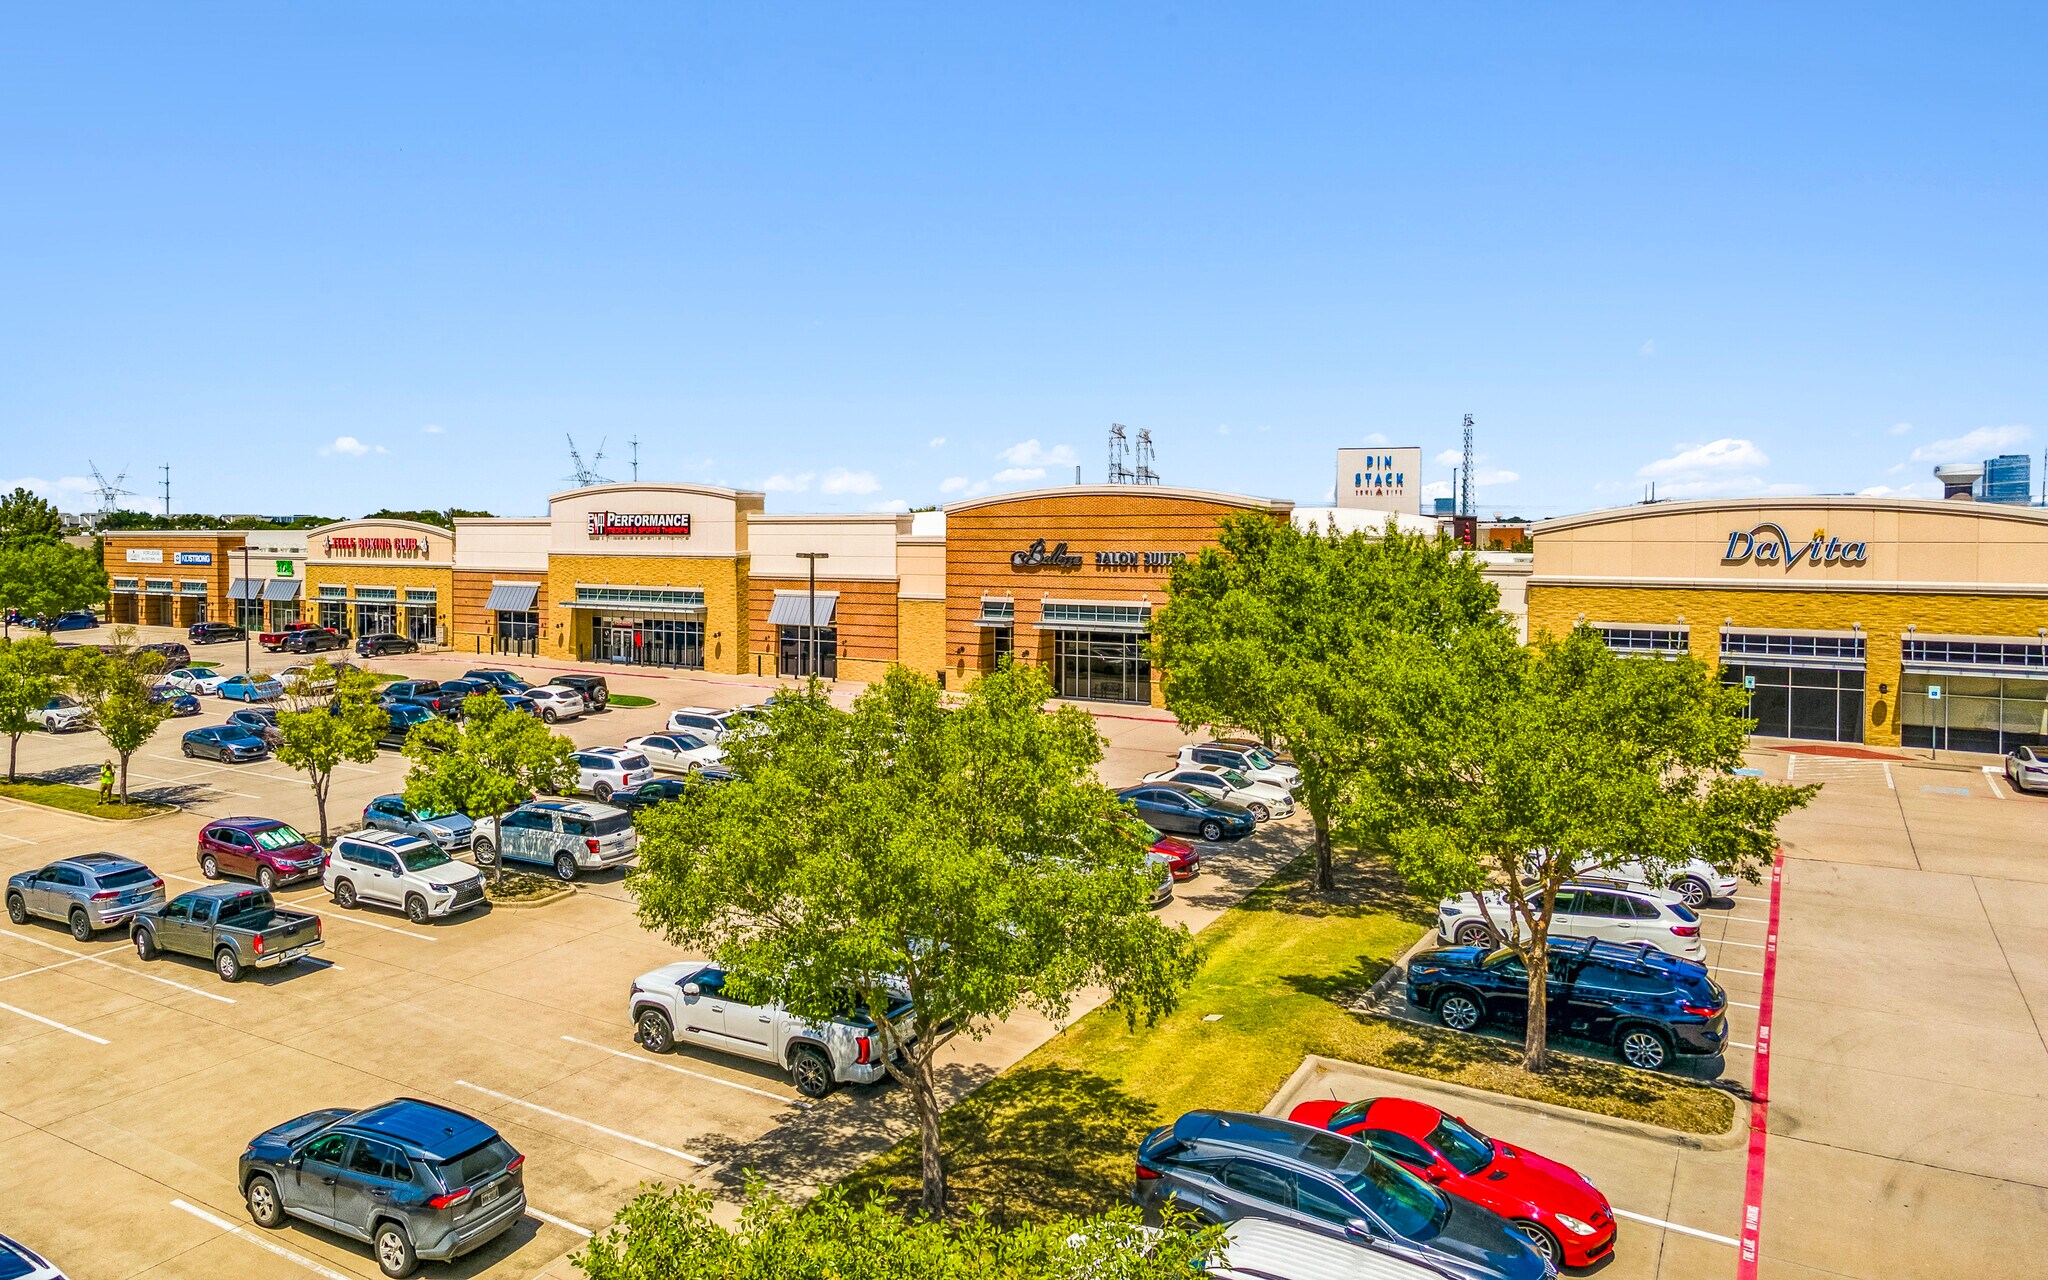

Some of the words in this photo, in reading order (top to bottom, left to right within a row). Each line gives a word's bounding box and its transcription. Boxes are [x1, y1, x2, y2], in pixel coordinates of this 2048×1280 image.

[1366, 455, 1392, 470] PIN
[1354, 472, 1404, 488] STACK
[607, 512, 689, 527] PERFORMANCE
[638, 526, 660, 534] SPORTS
[332, 537, 356, 549] TITLE
[358, 537, 391, 550] BOXING
[393, 537, 418, 551] CLUB
[1721, 522, 1869, 567] DaVita
[1095, 551, 1139, 566] SALON
